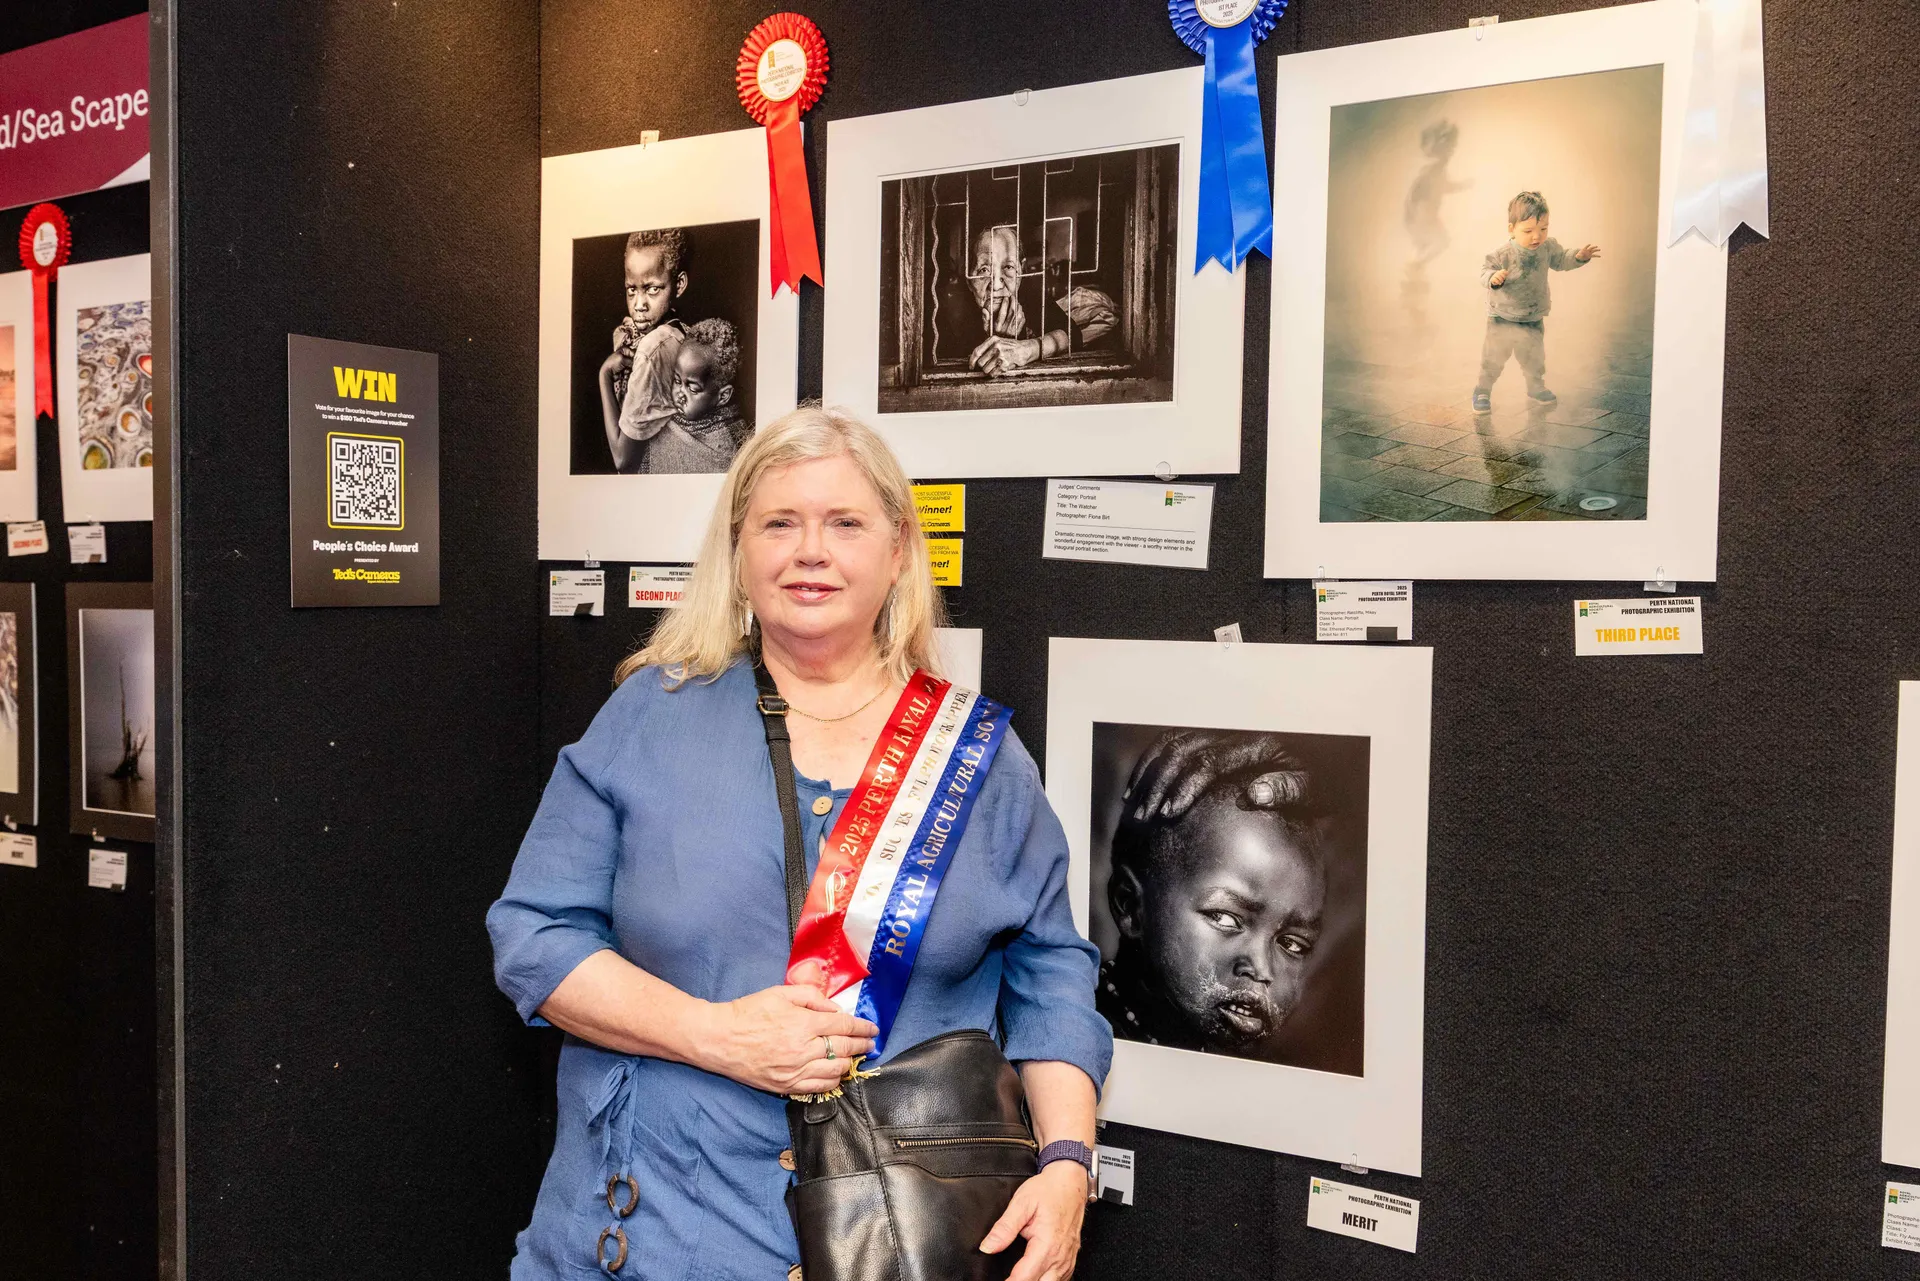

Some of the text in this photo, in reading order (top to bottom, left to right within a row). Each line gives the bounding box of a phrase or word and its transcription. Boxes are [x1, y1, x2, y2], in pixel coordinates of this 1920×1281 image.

[70, 89, 149, 132] Scape
[333, 366, 397, 403] WIN
[366, 409, 380, 417] image
[916, 505, 952, 514] Winner!
[313, 540, 419, 553] People's Choice Award
[931, 560, 950, 568] ner!
[333, 568, 400, 580] Ted's Cameras
[636, 590, 664, 601] SECOND
[1595, 627, 1680, 642] THIRD PLACE
[840, 813, 872, 858] 2025
[861, 745, 905, 817] PERTH
[884, 873, 929, 959] ROYAL
[916, 745, 986, 871] AGRICULTURAL
[1348, 1195, 1412, 1216] PHOTOGRAPHIC EXHIBITION
[1374, 1194, 1412, 1208] PERTH NATIONAL
[1342, 1212, 1378, 1232] MERIT
